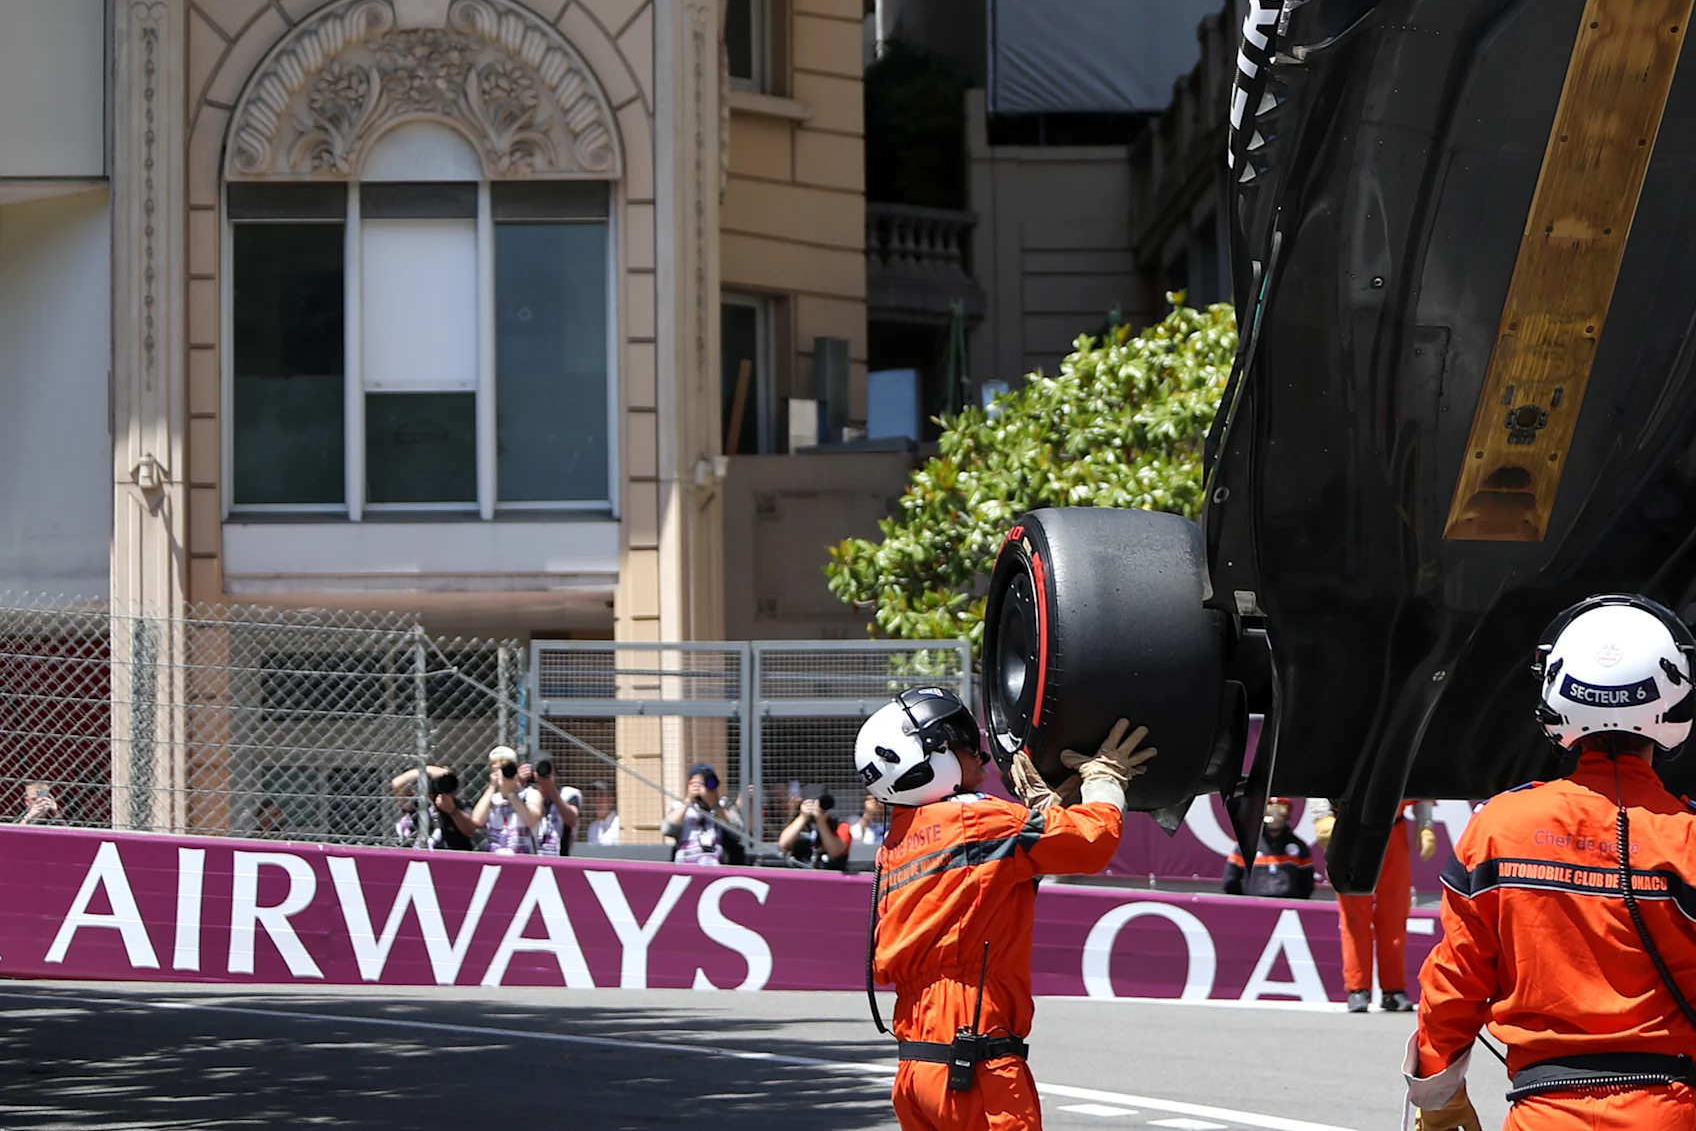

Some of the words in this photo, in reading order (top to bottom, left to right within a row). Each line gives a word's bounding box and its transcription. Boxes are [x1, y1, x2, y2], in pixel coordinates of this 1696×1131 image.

[1570, 683, 1631, 704] SECTEUR
[1636, 687, 1648, 700] 6
[906, 823, 941, 852] POSTE
[1535, 830, 1572, 848] Chef
[1575, 836, 1594, 852] de
[1498, 862, 1572, 883] AUTOMOBILE
[1573, 870, 1604, 888] CLUB
[1604, 873, 1620, 888] DE
[1620, 874, 1668, 891] ONACO
[44, 841, 774, 991] AIRWAYS
